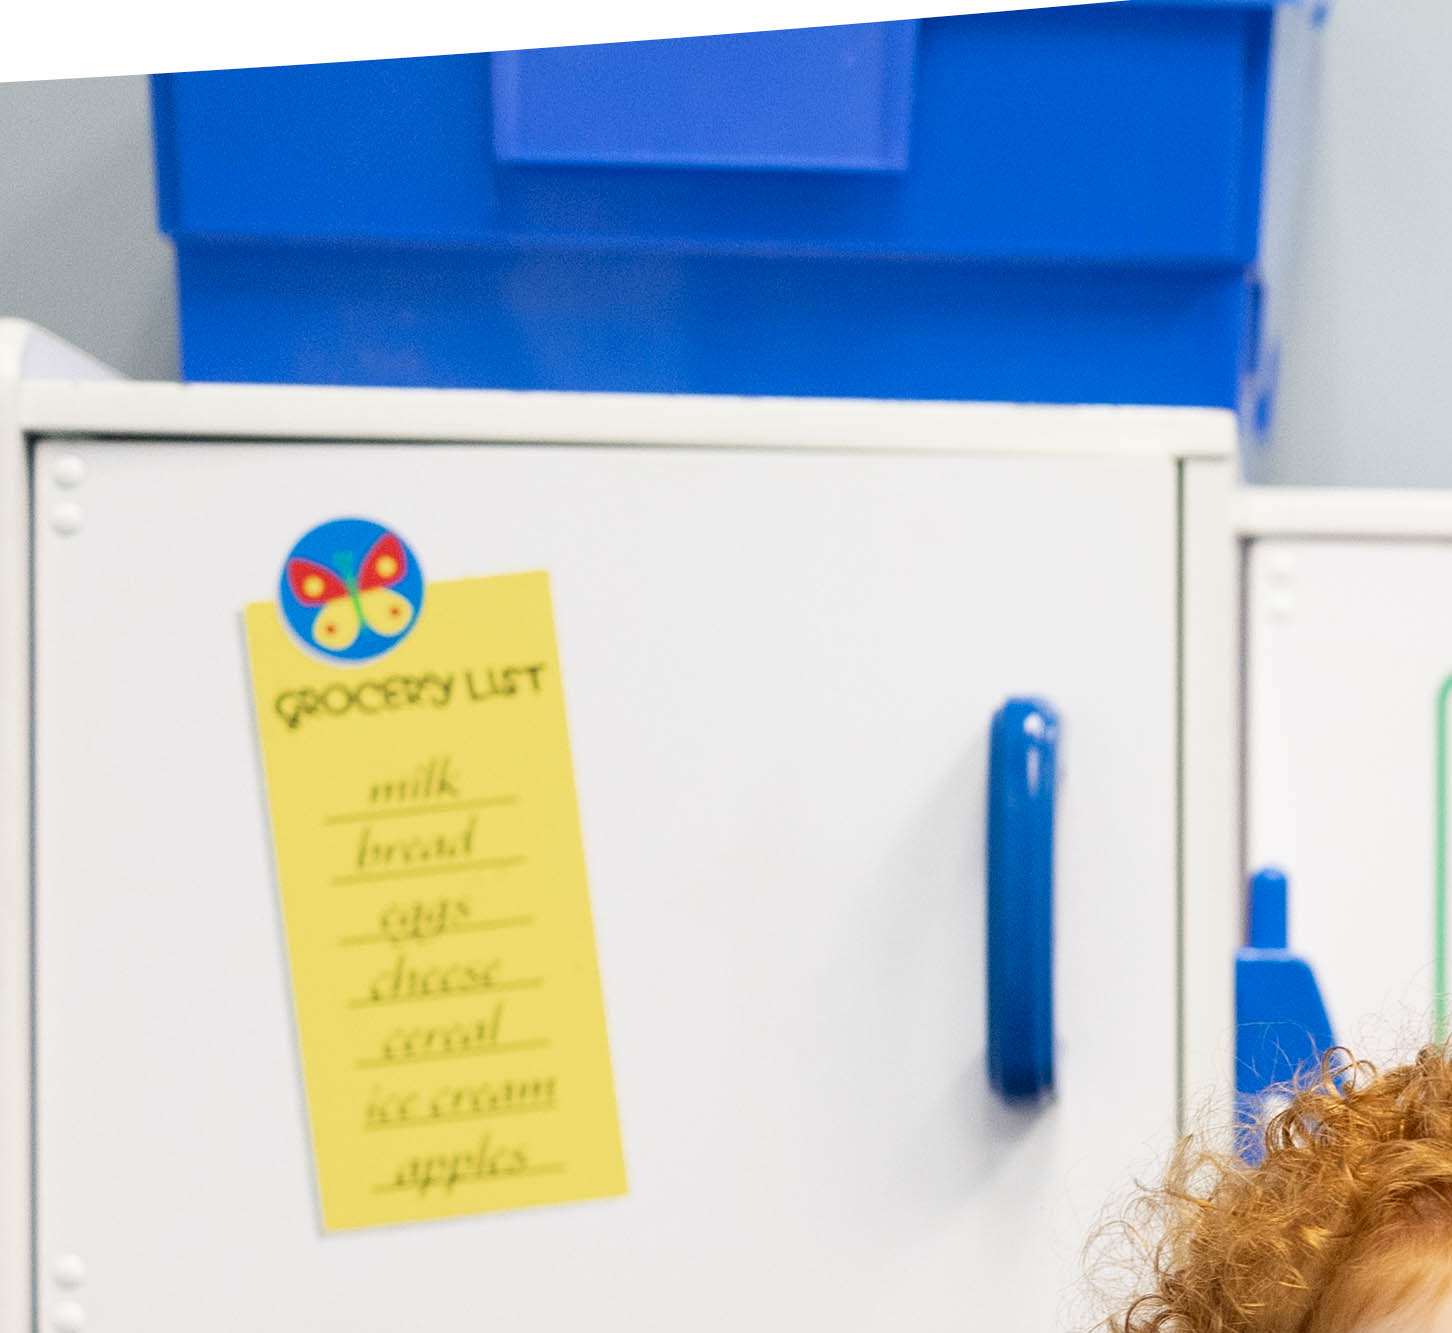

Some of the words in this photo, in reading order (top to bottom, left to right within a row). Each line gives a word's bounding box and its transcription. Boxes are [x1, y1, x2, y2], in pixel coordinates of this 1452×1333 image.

[275, 672, 453, 730] GROCERY
[466, 664, 547, 704] LIST
[369, 756, 460, 807] milk
[356, 815, 478, 870] bread
[378, 899, 473, 948] eggs
[367, 955, 503, 1003] cheese
[381, 1003, 504, 1061] cereal
[364, 1085, 416, 1126] ice
[427, 1074, 557, 1118] cream
[394, 1133, 530, 1197] apples
